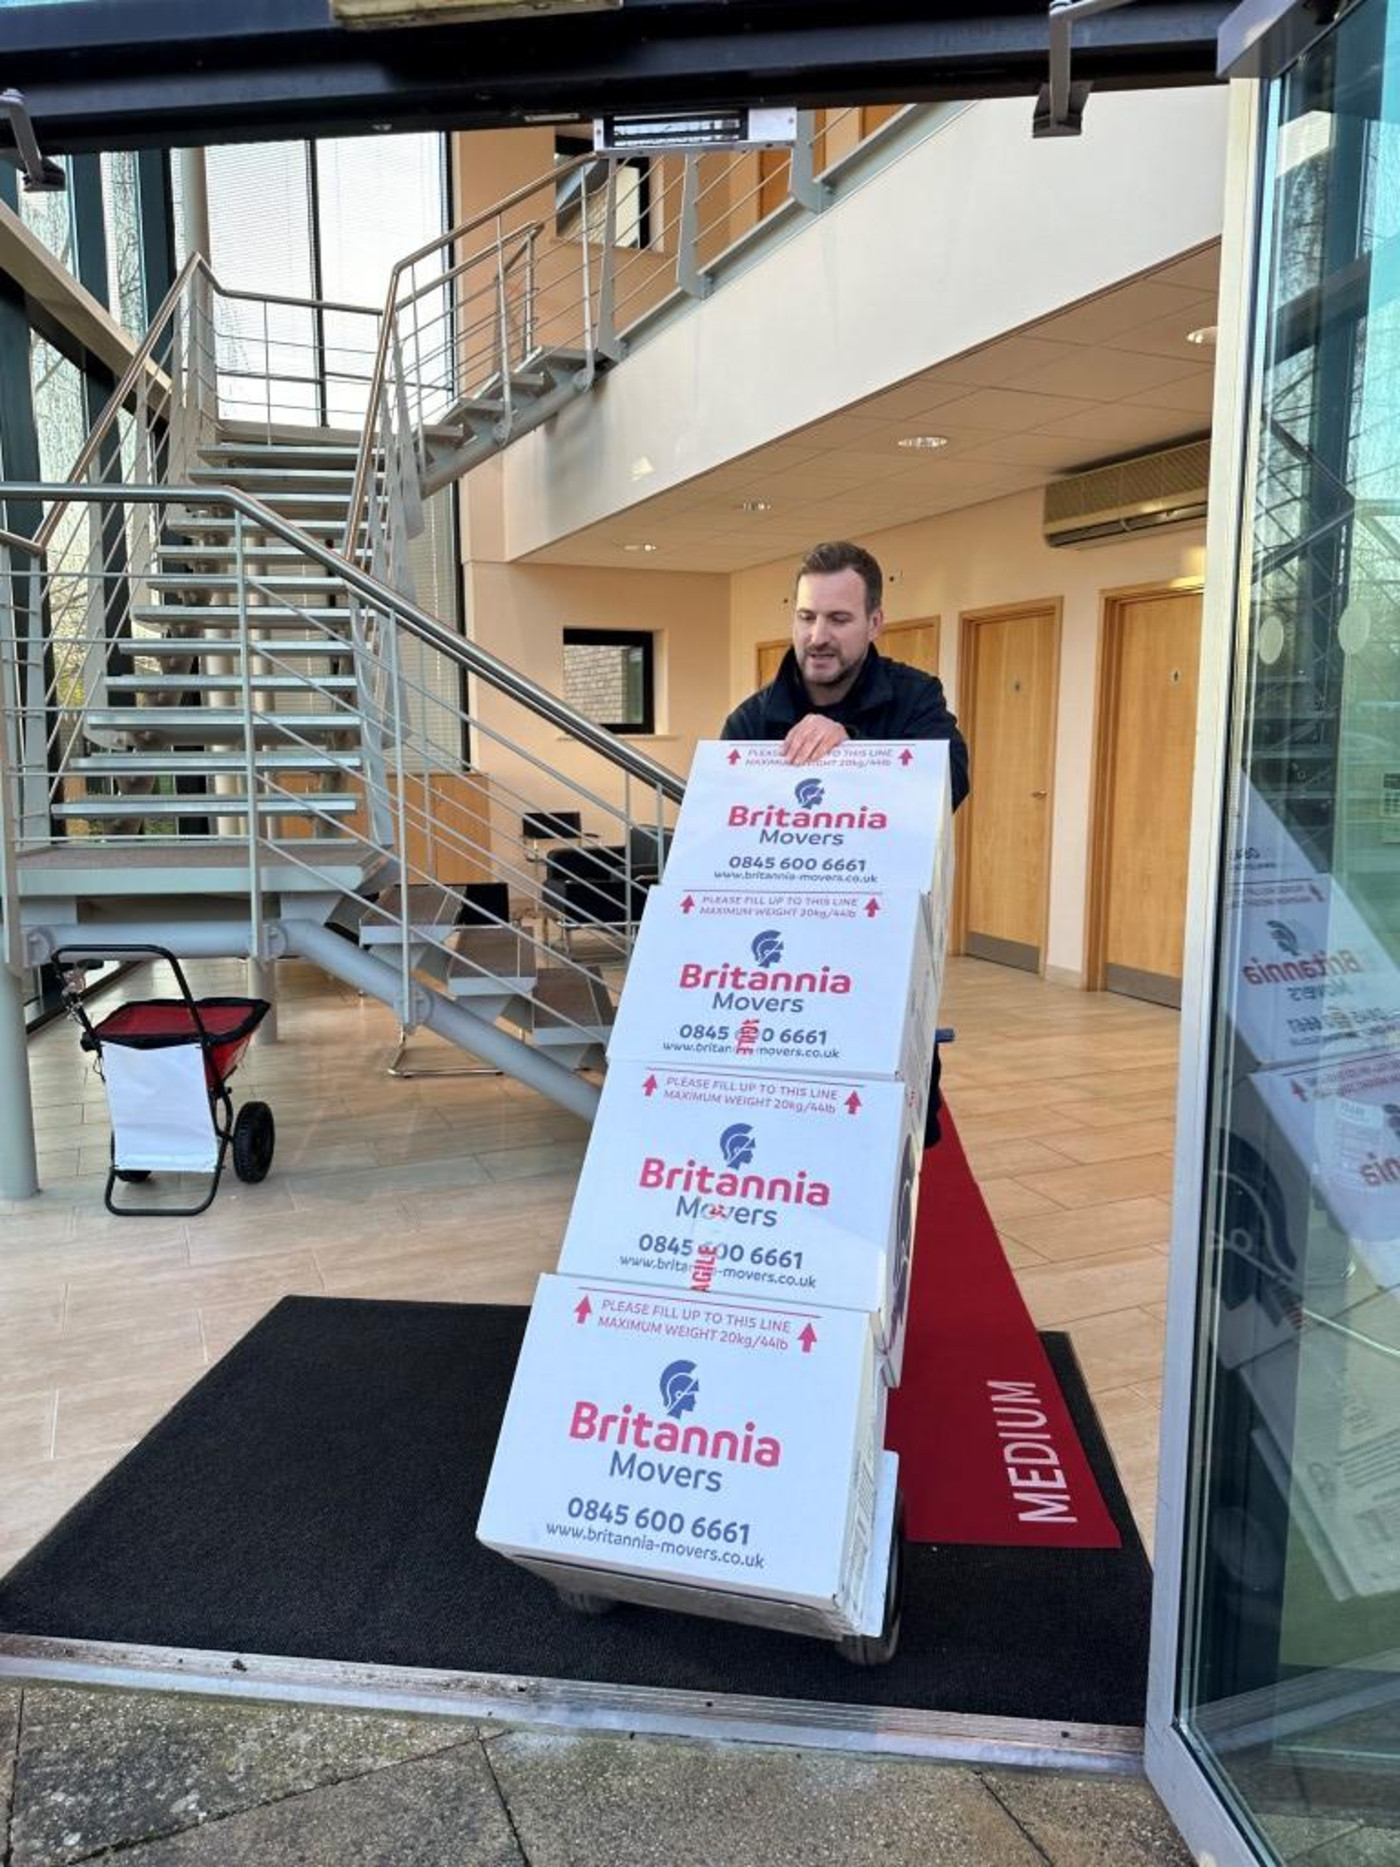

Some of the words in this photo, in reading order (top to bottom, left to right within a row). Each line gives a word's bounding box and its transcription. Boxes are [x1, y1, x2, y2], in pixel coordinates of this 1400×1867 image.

[745, 759, 790, 768] MAXIMU
[747, 749, 784, 758] PLEAS
[843, 749, 867, 758] THIS
[869, 749, 894, 758] LINE
[728, 805, 888, 829] Britannia
[759, 829, 844, 846] Movers
[729, 856, 775, 869] 0845
[780, 857, 817, 871] 600
[822, 858, 867, 872] 6661
[714, 870, 879, 884] www.britannia-movers.co.uk
[699, 906, 752, 917] MAXIMUM
[754, 907, 798, 918] WEIGHT
[800, 908, 857, 920] 20kg/44lb
[701, 896, 743, 906] PLEASE
[744, 896, 766, 906] FILL
[768, 897, 784, 906] UP
[786, 897, 802, 907] TO
[805, 897, 831, 907] THIS
[833, 898, 859, 908] LINE
[679, 963, 851, 994] Britannia
[711, 992, 804, 1013] Movers
[679, 1024, 730, 1041] 0845
[779, 1028, 828, 1045] 6661
[666, 1077, 710, 1090] PLEASE
[712, 1079, 738, 1092] FILL
[740, 1081, 757, 1093] UP
[760, 1083, 777, 1095] TO
[780, 1085, 807, 1098] THIS
[810, 1088, 838, 1101] LINE
[663, 1089, 722, 1105] MAXIMUM
[724, 1094, 771, 1109] WEIGHT
[774, 1098, 837, 1115] 20kg/44lb
[640, 1158, 831, 1207] Britannia
[639, 1233, 693, 1256] 0845
[698, 1241, 745, 1262] 00
[750, 1246, 803, 1270] 6661
[601, 1299, 650, 1316] PLEASE
[652, 1304, 679, 1319] FILL
[681, 1307, 701, 1321] UP
[704, 1310, 723, 1325] TO
[726, 1313, 758, 1330] THIS
[760, 1318, 791, 1334] LINE
[597, 1315, 662, 1335] MAXIMUM
[665, 1323, 718, 1341] WEIGHT
[720, 1330, 789, 1352] 20kg/44lb
[569, 1401, 782, 1469] Britannia
[986, 1379, 1078, 1523] MEDIUM
[609, 1449, 723, 1492] Movers
[567, 1496, 629, 1526] 0845
[635, 1507, 685, 1535] 600
[690, 1516, 751, 1546] 6661
[546, 1521, 765, 1569] www.britannia-movers.co.uk
